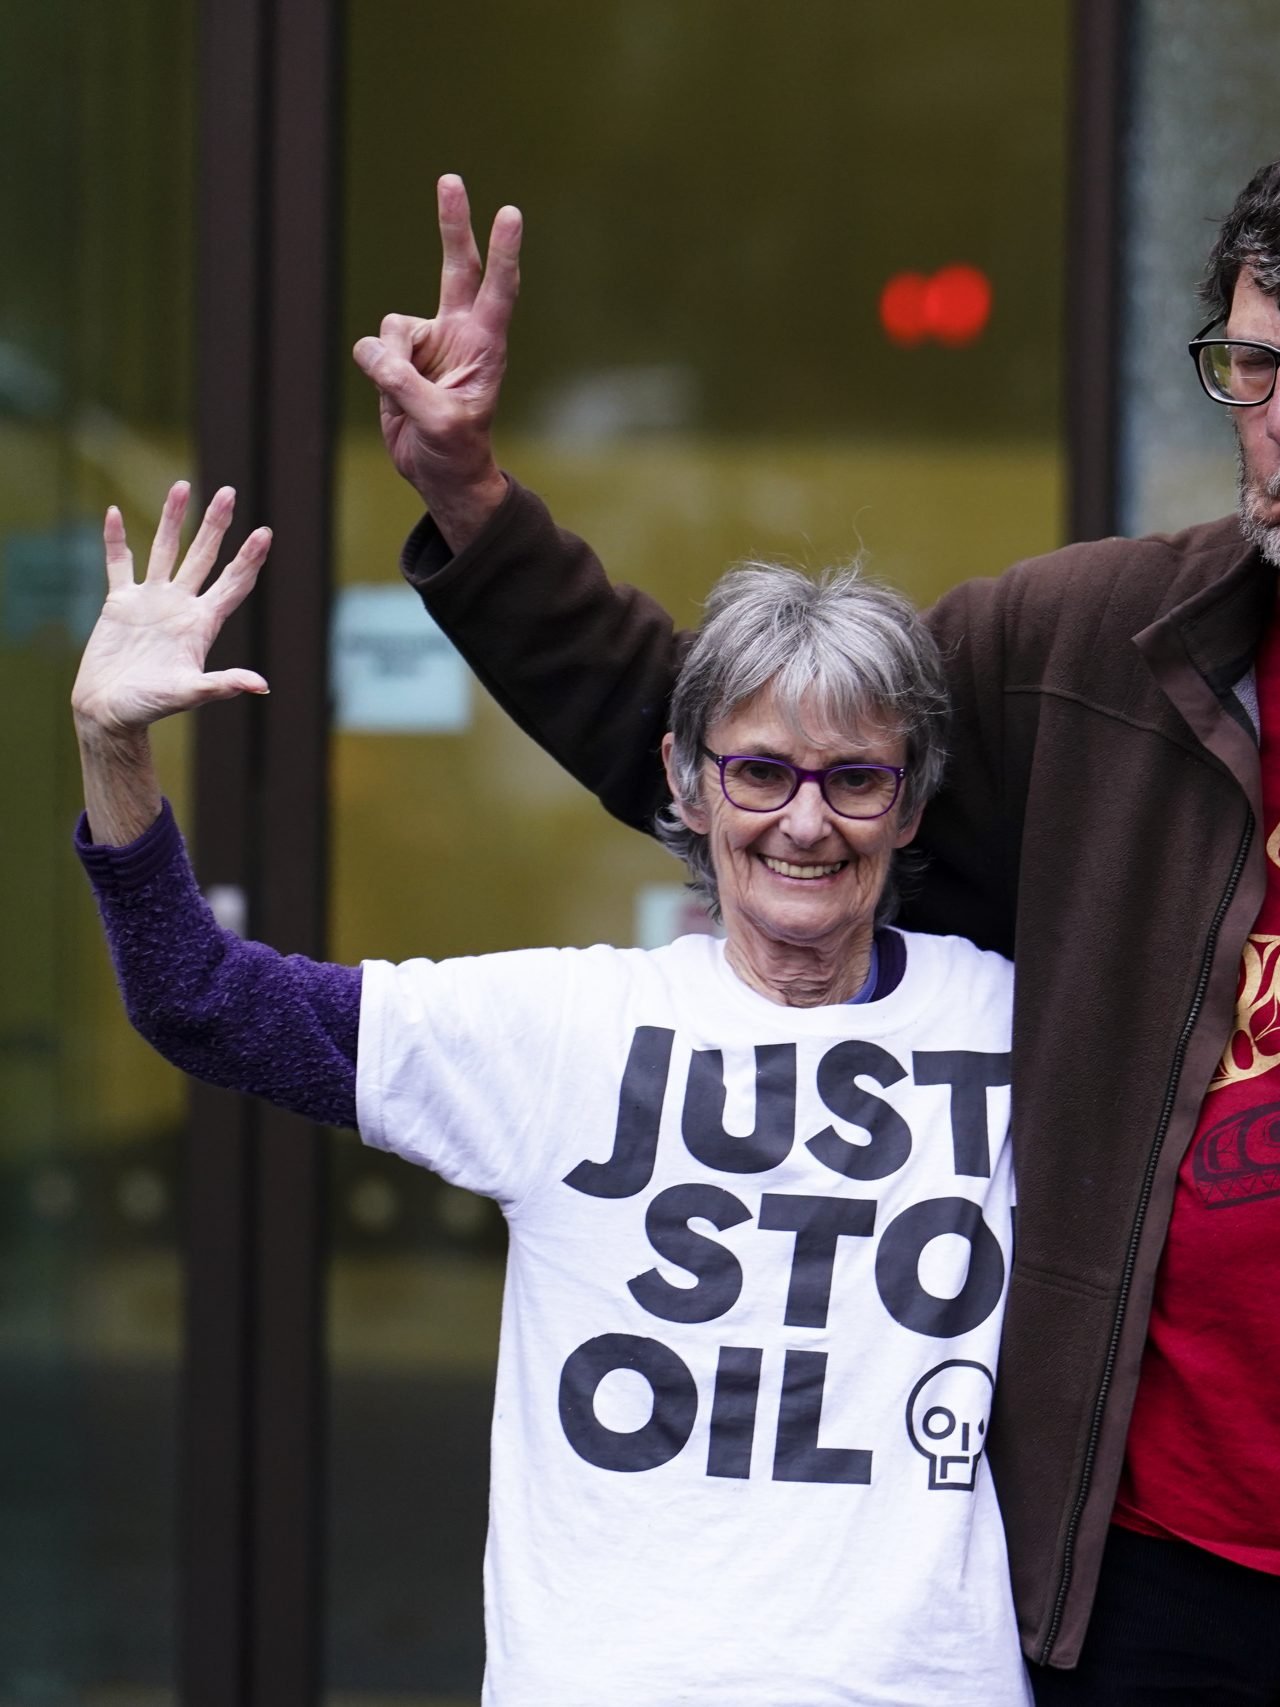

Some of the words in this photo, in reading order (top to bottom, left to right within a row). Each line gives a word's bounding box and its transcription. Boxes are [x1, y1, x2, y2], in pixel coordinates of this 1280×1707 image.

[561, 1026, 1011, 1199] JUST
[627, 1183, 1016, 1338] STO
[559, 1333, 873, 1485] OIL
